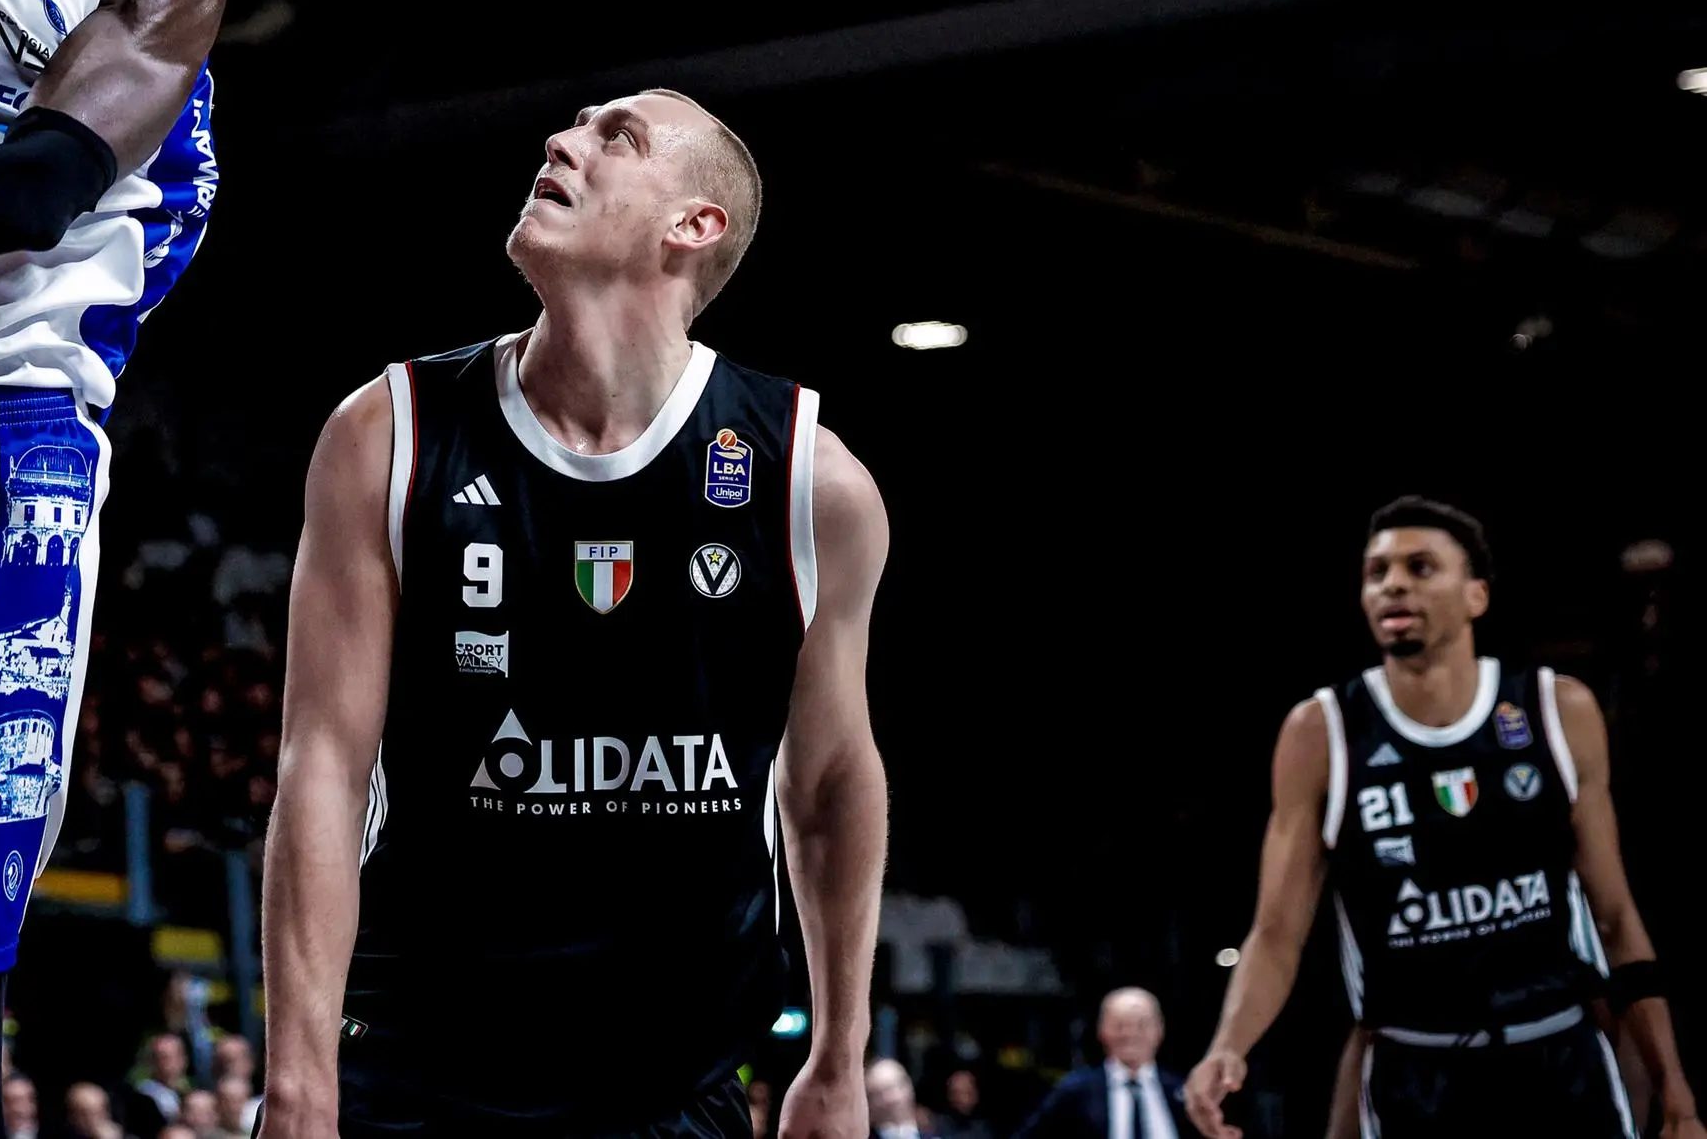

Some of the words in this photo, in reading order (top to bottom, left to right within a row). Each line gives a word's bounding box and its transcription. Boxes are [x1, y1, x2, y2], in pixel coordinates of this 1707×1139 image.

[713, 461, 746, 476] LBA
[715, 486, 743, 499] Unipol
[589, 546, 618, 558] FIP
[462, 542, 504, 608] 9
[456, 643, 505, 657] SPORT
[456, 655, 504, 668] VALLEY
[470, 797, 504, 812] THE
[516, 801, 592, 816] POWER
[606, 800, 629, 813] OF
[642, 797, 742, 815] PIONEERS
[1357, 781, 1415, 833] 21
